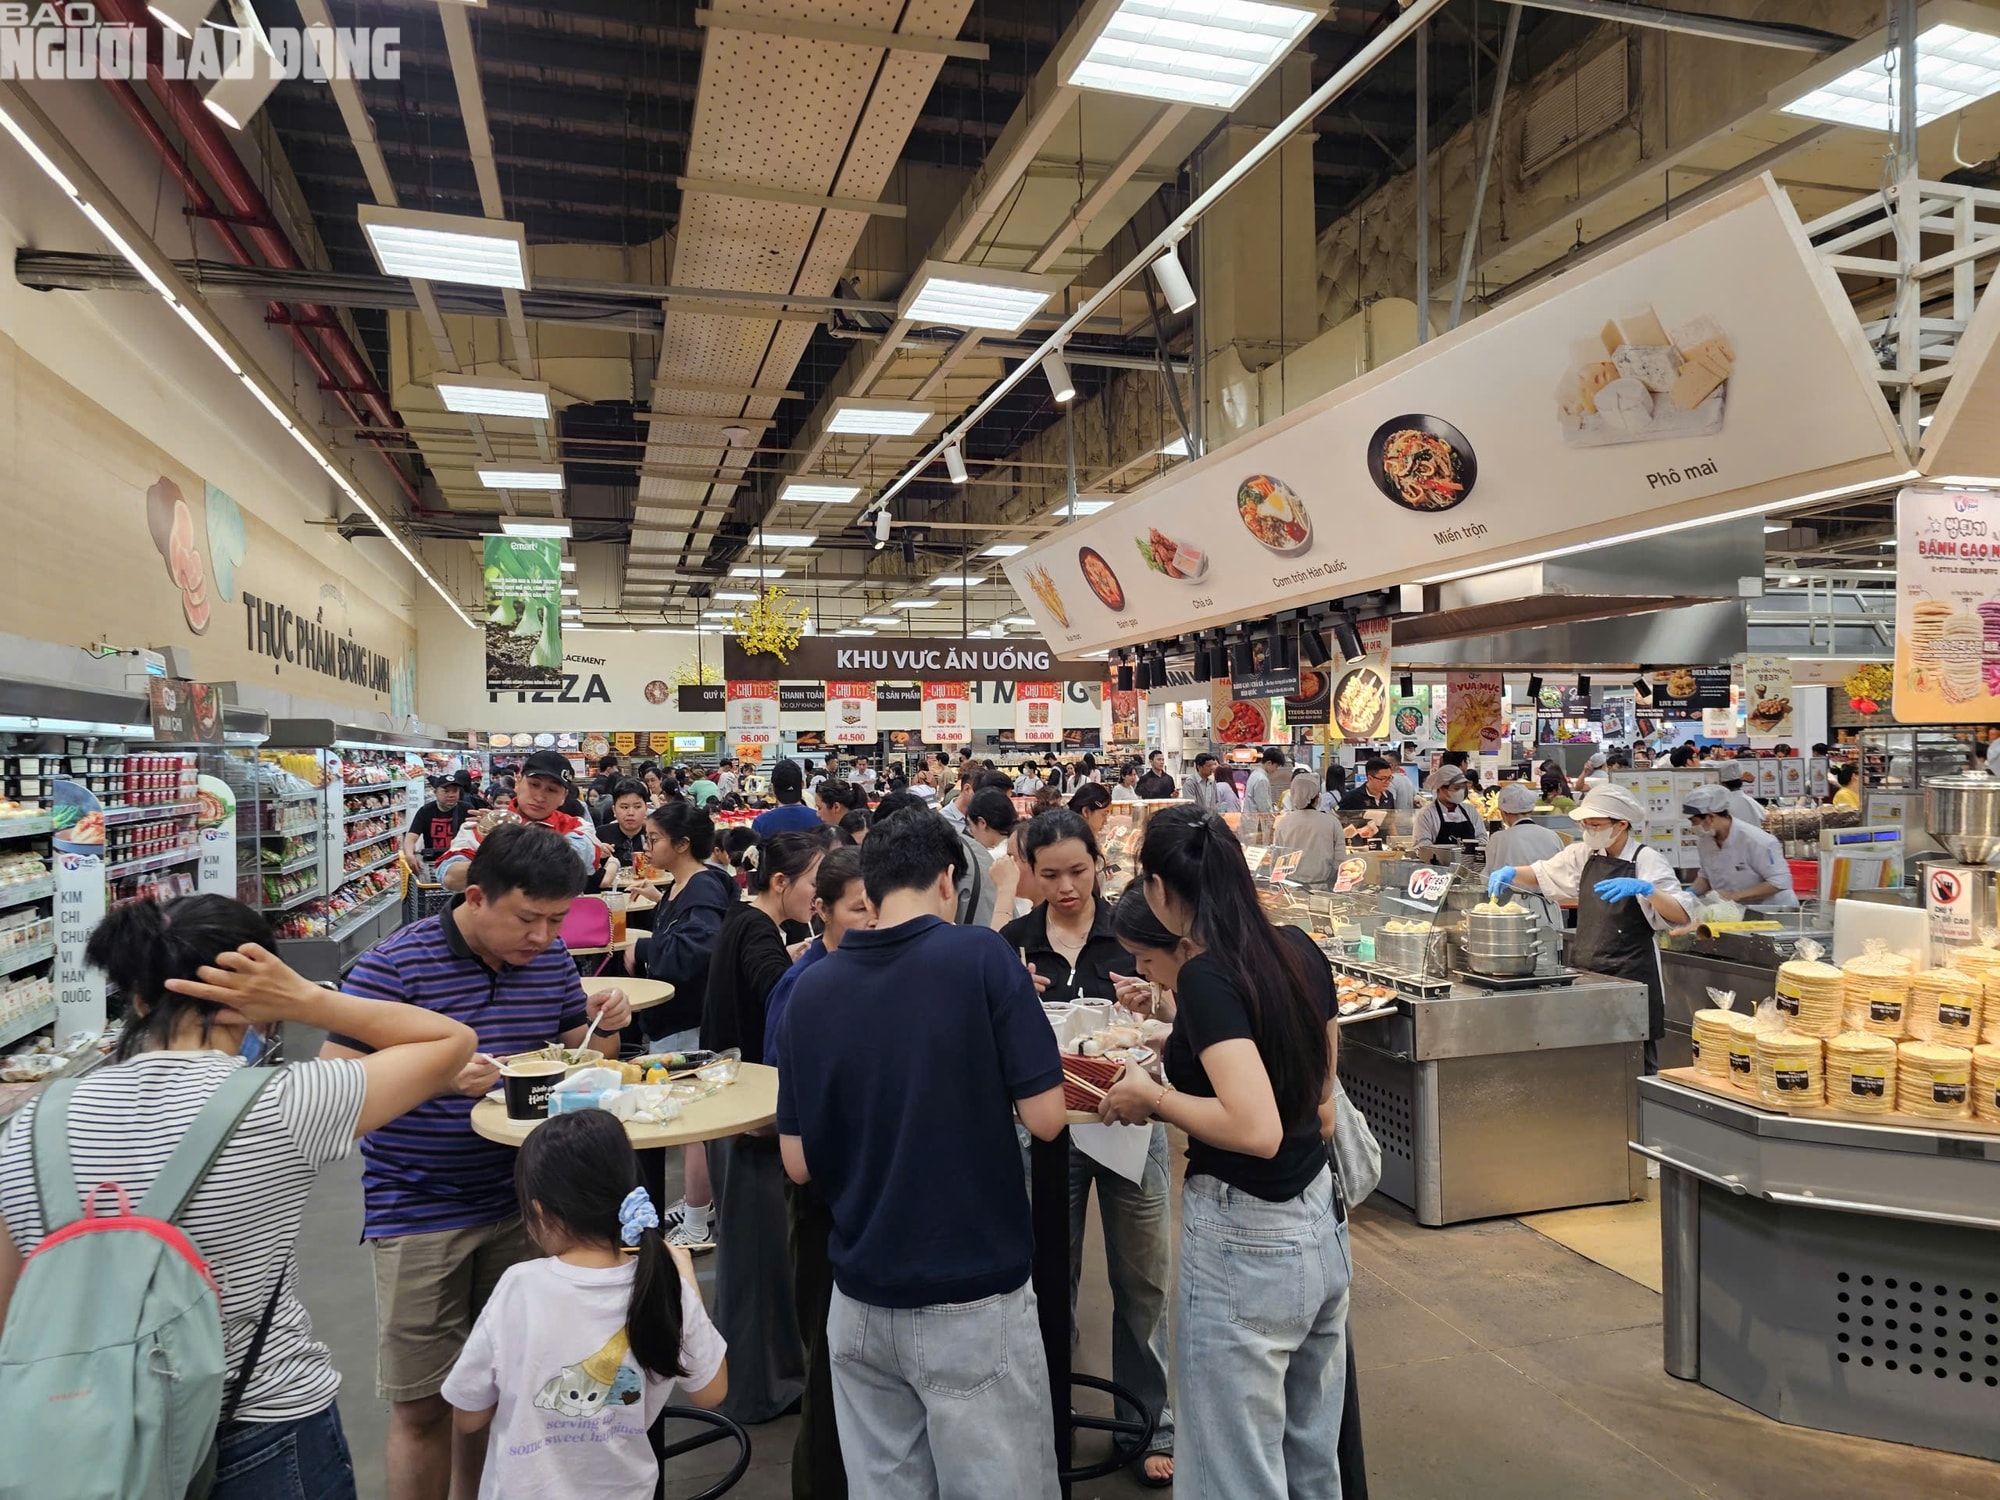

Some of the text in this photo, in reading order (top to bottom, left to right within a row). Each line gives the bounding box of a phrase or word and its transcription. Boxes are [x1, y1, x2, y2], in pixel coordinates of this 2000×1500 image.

[1646, 458, 1718, 489] Phô mai
[1433, 523, 1488, 545] Miến trộn
[1919, 539, 1956, 556] BÁNH
[1272, 559, 1348, 588] Cơm trộn Hàn Quốc
[243, 591, 390, 702] THỰC PHẨM ĐÔNG LẠNH
[562, 654, 606, 666] ACEMENT
[837, 646, 1050, 673] KHU VỰC ĂN UỐNG
[780, 691, 804, 699] THANH
[805, 689, 825, 699] TOÁN
[1456, 682, 1500, 694] VUA MỰC
[740, 734, 769, 743] 96.000
[837, 733, 865, 742] 44.500
[936, 732, 963, 741] 84.900
[204, 855, 220, 865] KIM
[204, 870, 218, 880] CHI
[61, 891, 83, 904] KIM
[61, 911, 80, 924] CHI
[61, 968, 86, 984] HÀN
[61, 986, 92, 1004] QUỐC
[546, 1410, 616, 1432] serving up
[509, 1440, 542, 1456] some
[544, 1432, 585, 1446] sweet
